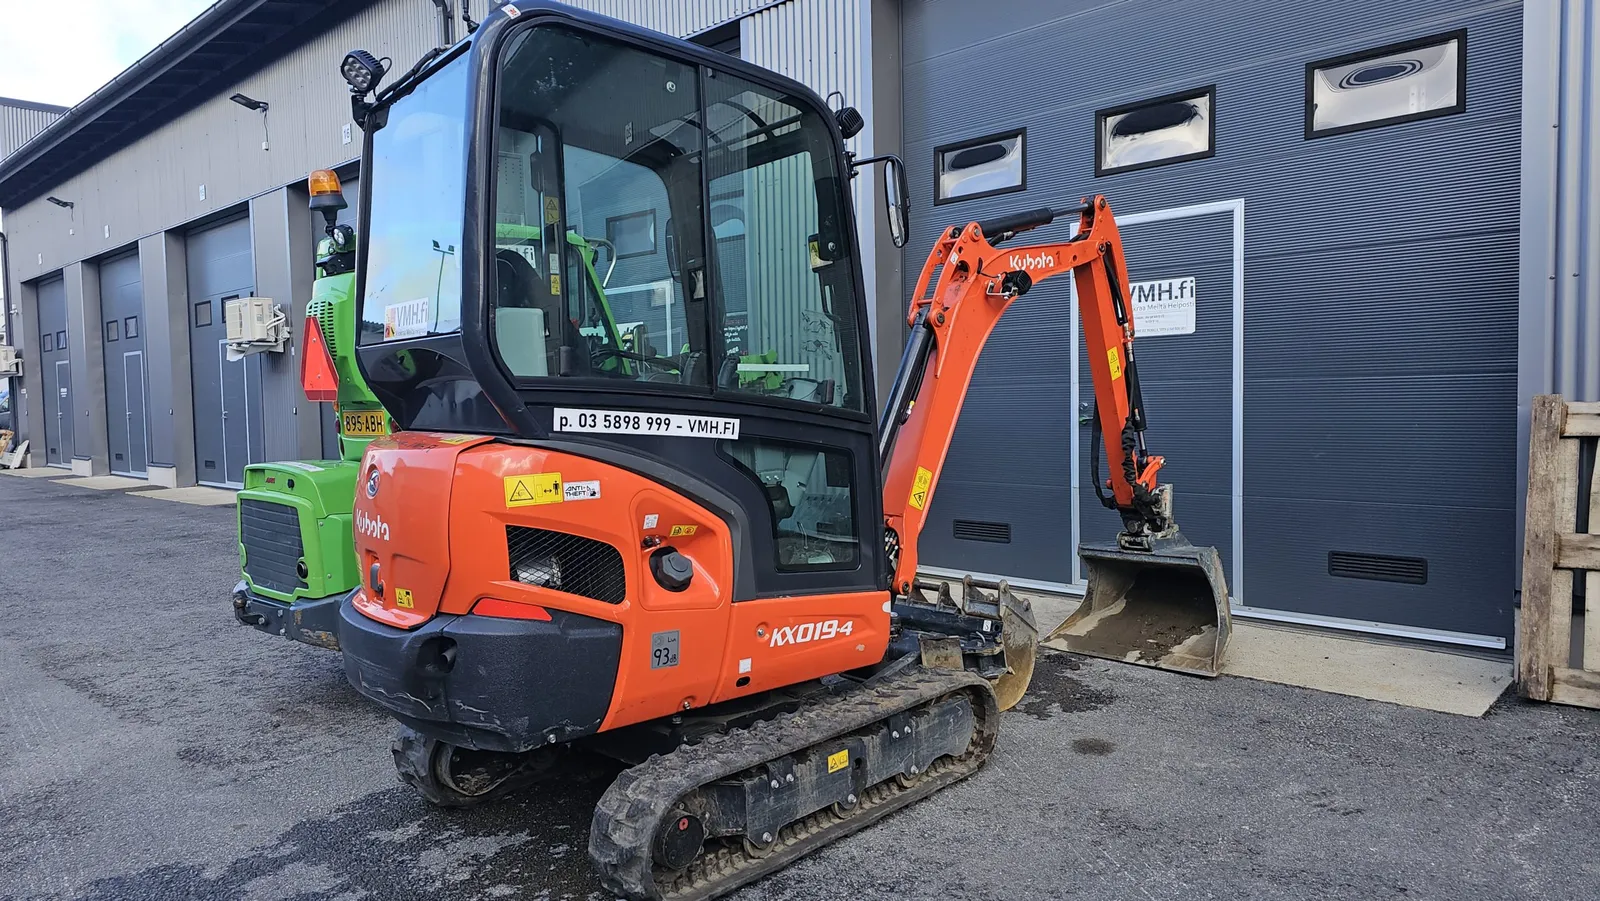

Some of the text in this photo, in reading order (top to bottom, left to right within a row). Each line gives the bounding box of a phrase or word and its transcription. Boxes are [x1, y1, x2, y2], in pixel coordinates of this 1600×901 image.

[1009, 251, 1054, 271] Kubota
[397, 302, 429, 327] VMH.fi
[345, 415, 384, 433] 895-ABH
[560, 416, 572, 431] p.
[579, 413, 597, 429] 03
[604, 414, 640, 430] 5898
[646, 416, 671, 432] 999
[688, 419, 735, 436] VMH.FI
[356, 508, 390, 541] Kubota
[769, 619, 853, 647] KX019-4
[653, 647, 670, 666] 93
